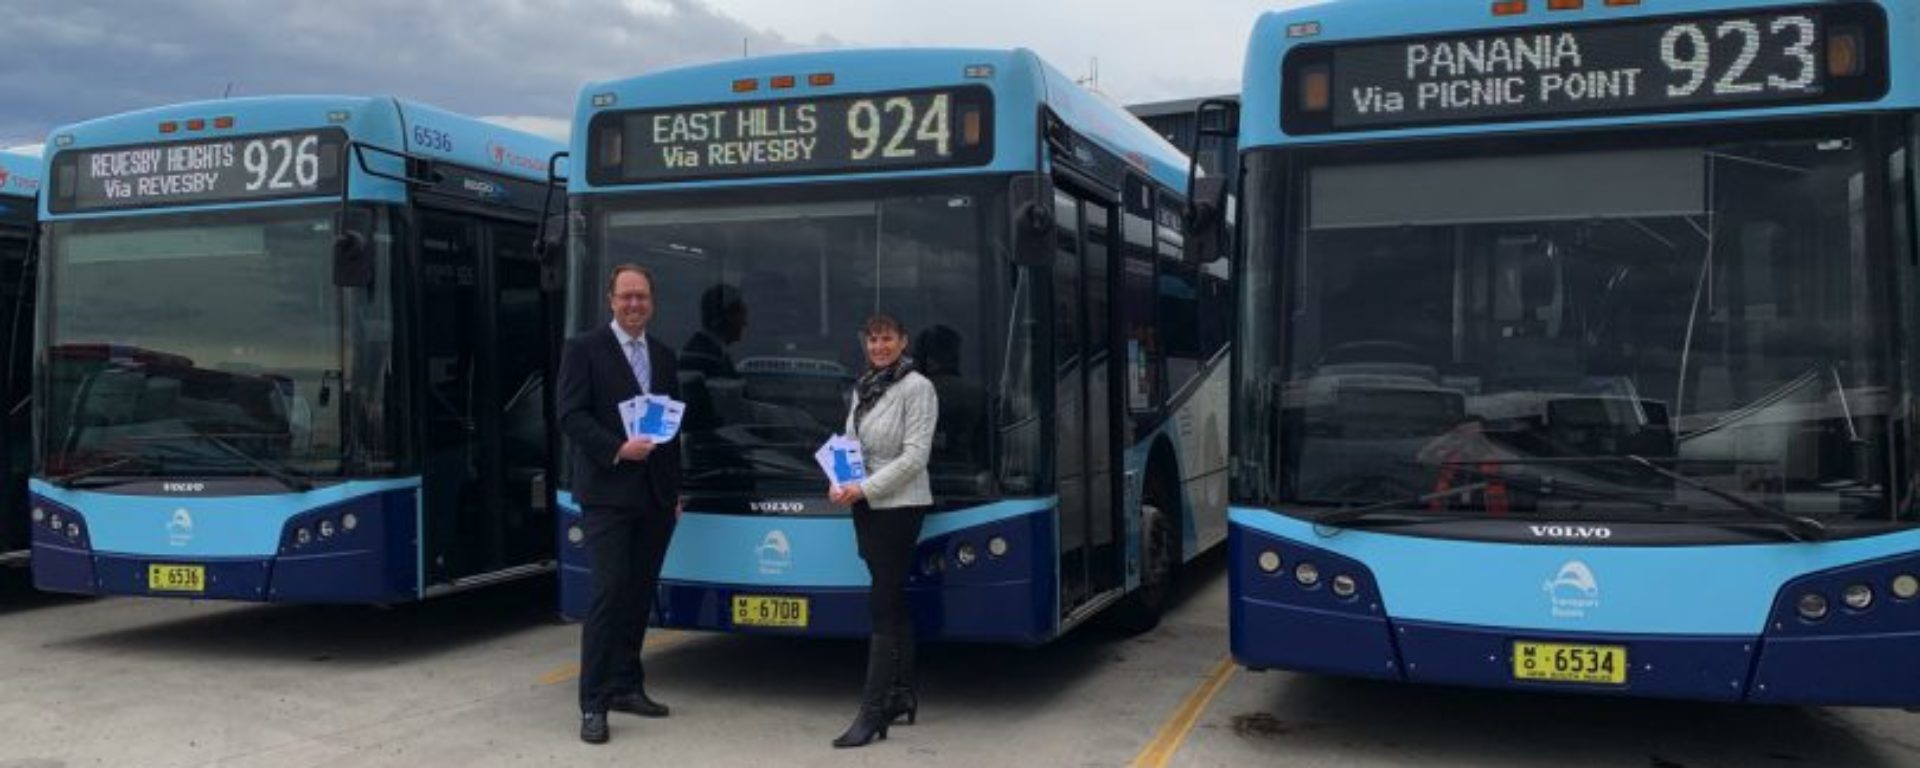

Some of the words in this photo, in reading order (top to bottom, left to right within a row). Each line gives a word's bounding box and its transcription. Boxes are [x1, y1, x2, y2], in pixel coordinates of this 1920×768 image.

[1406, 32, 1581, 79] PANANIA
[1661, 15, 1814, 96] 923
[1352, 86, 1404, 113] Via
[1418, 76, 1525, 109] PICNIC
[1540, 68, 1641, 101] POINT
[414, 125, 452, 152] 6536
[653, 111, 726, 143] EAST
[737, 104, 817, 137] HILLS
[847, 94, 949, 159] 924
[91, 150, 161, 178] REVESBY
[168, 143, 233, 171] HEIGHTS
[243, 135, 318, 191] 926
[663, 146, 699, 168] Via
[708, 137, 816, 165] REVESBY
[104, 179, 131, 198] Via
[137, 173, 219, 197] REVESBY
[749, 501, 805, 512] VOLVO
[1530, 525, 1612, 538] VOLVO
[760, 601, 800, 619] 6708
[1554, 648, 1614, 674] 6534
